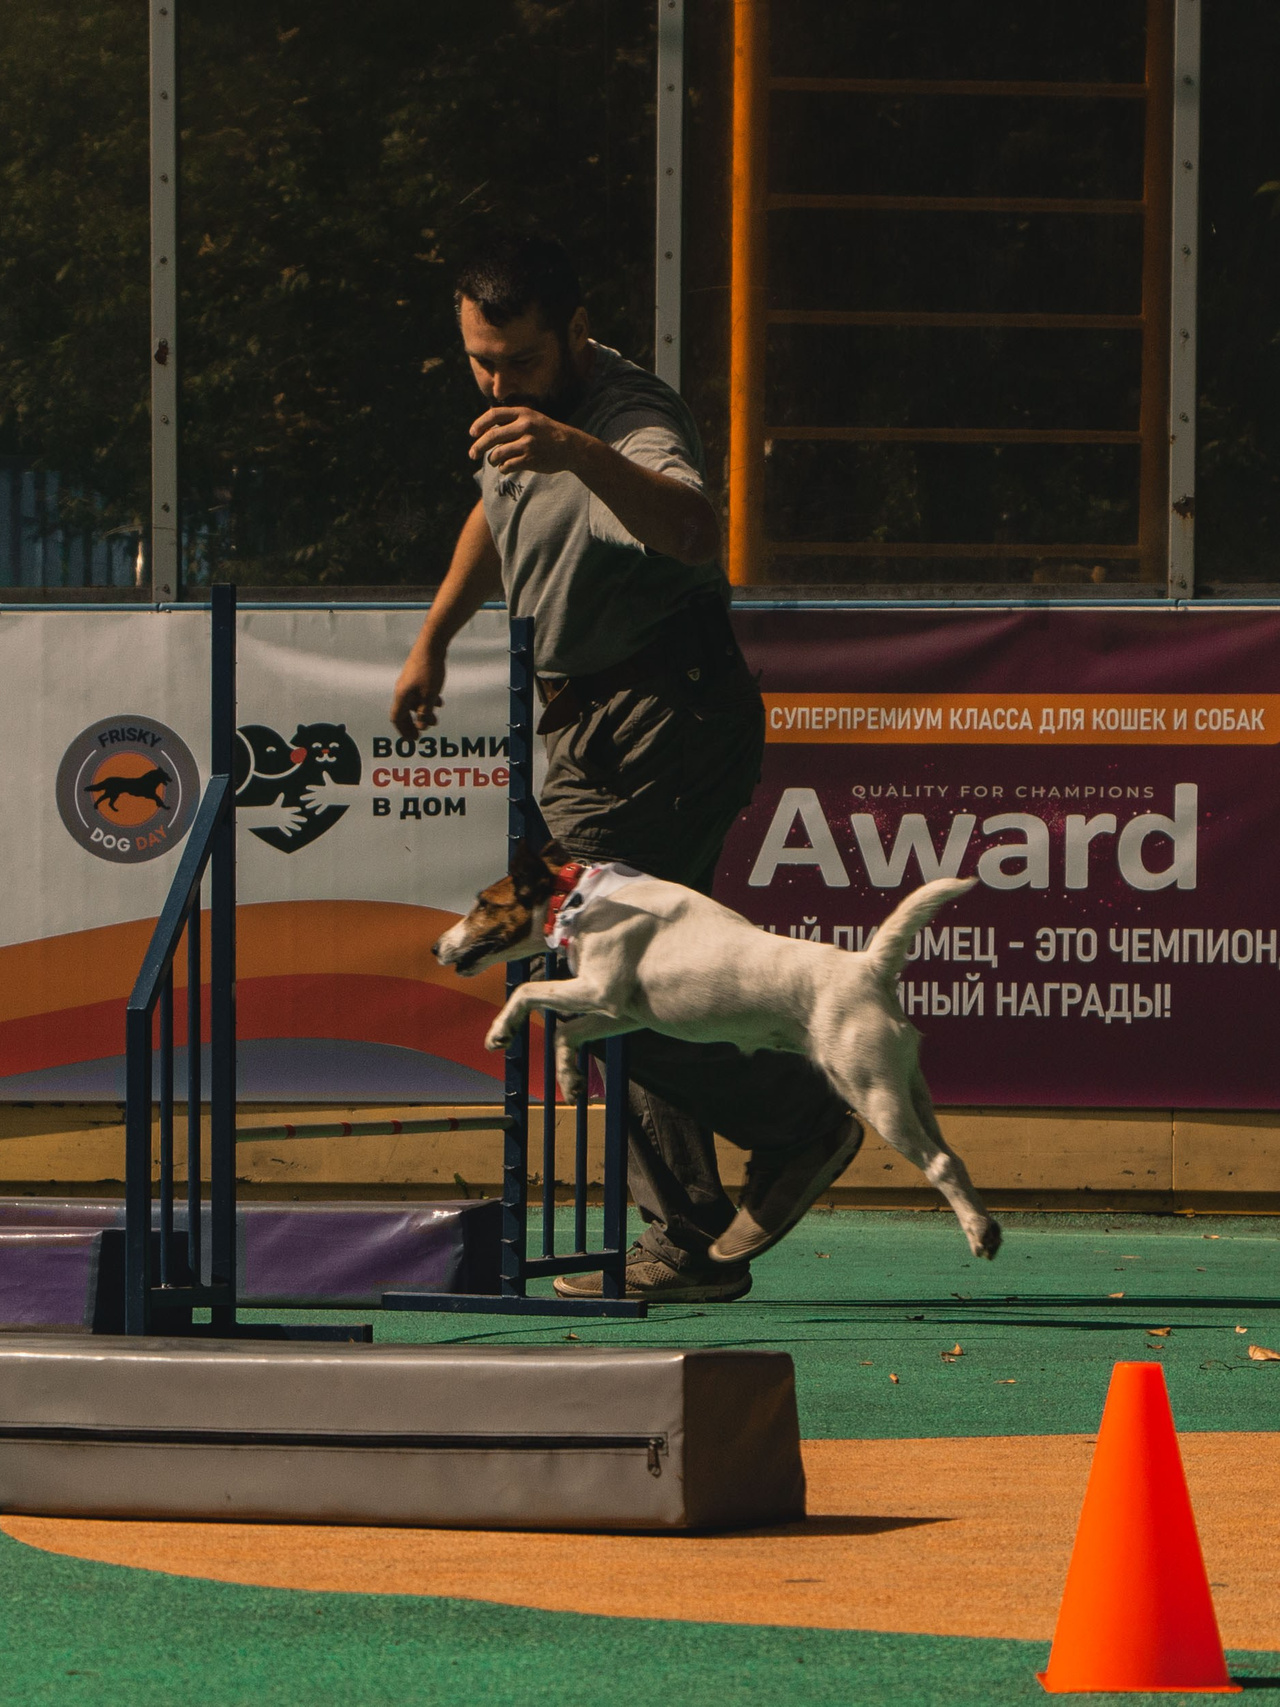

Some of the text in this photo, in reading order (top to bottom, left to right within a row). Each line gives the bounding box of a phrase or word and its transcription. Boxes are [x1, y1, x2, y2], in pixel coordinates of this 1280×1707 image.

[770, 707, 1265, 734] СУПЕРПРЕМИУМ КЛАССА ДЛЯ КОШЕК И СОБАК
[98, 727, 162, 748] FRISKY
[373, 736, 510, 758] возьми
[372, 767, 510, 787] счастье
[852, 785, 1154, 799] QUALITY FOR CHAMPIONS
[373, 797, 466, 820] в дом
[90, 825, 167, 852] DOG DAY
[748, 783, 1198, 890] Award
[1035, 928, 1098, 962] ЭТО
[996, 982, 1171, 1024] НАГРАДЫ!
